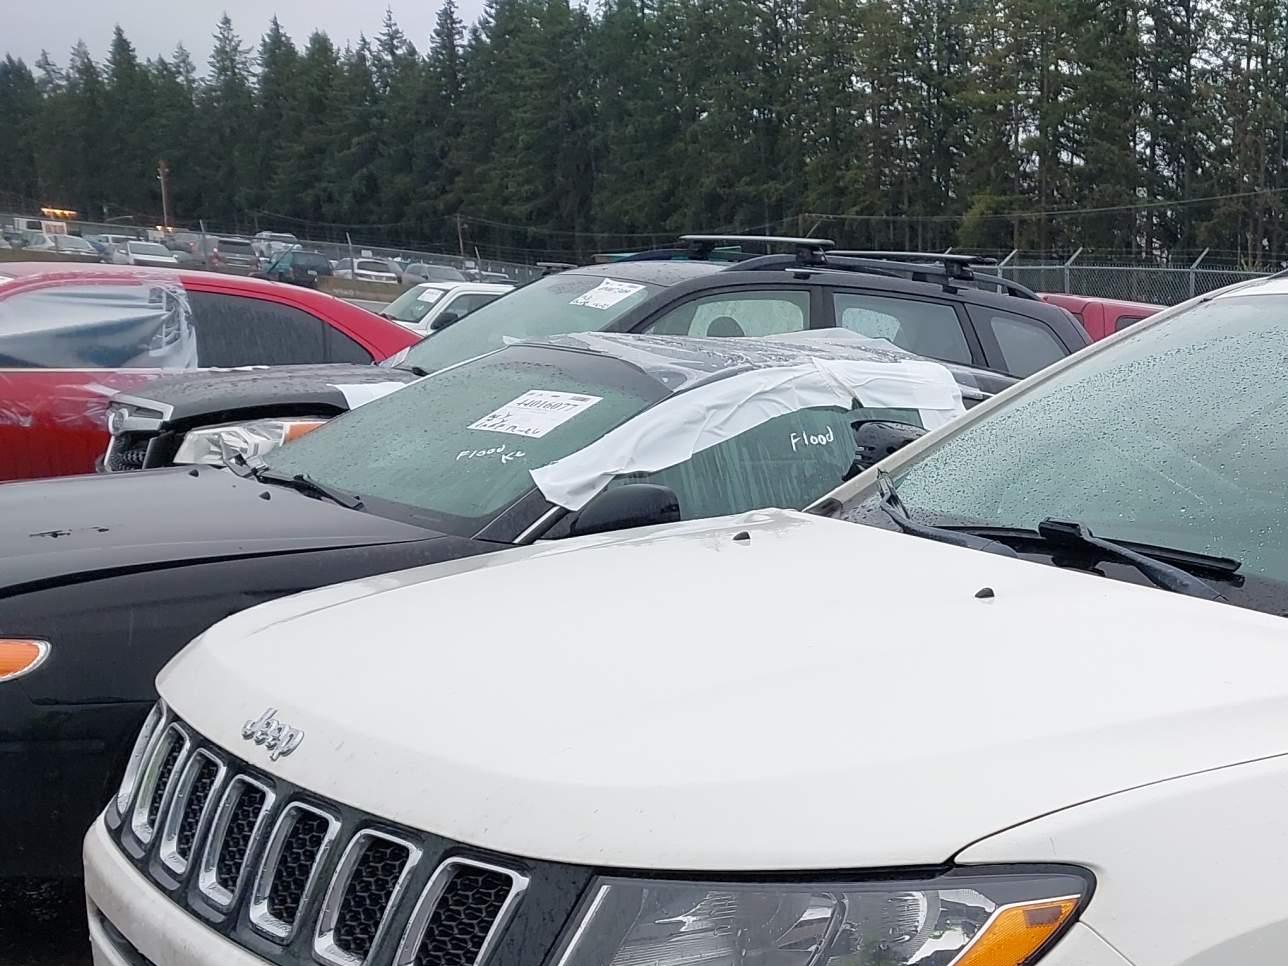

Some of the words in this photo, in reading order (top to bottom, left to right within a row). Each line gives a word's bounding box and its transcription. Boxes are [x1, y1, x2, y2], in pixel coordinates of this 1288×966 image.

[516, 399, 579, 411] 44016077
[789, 425, 834, 452] Flood
[456, 444, 506, 461] Flood
[241, 707, 304, 762] Jeep
